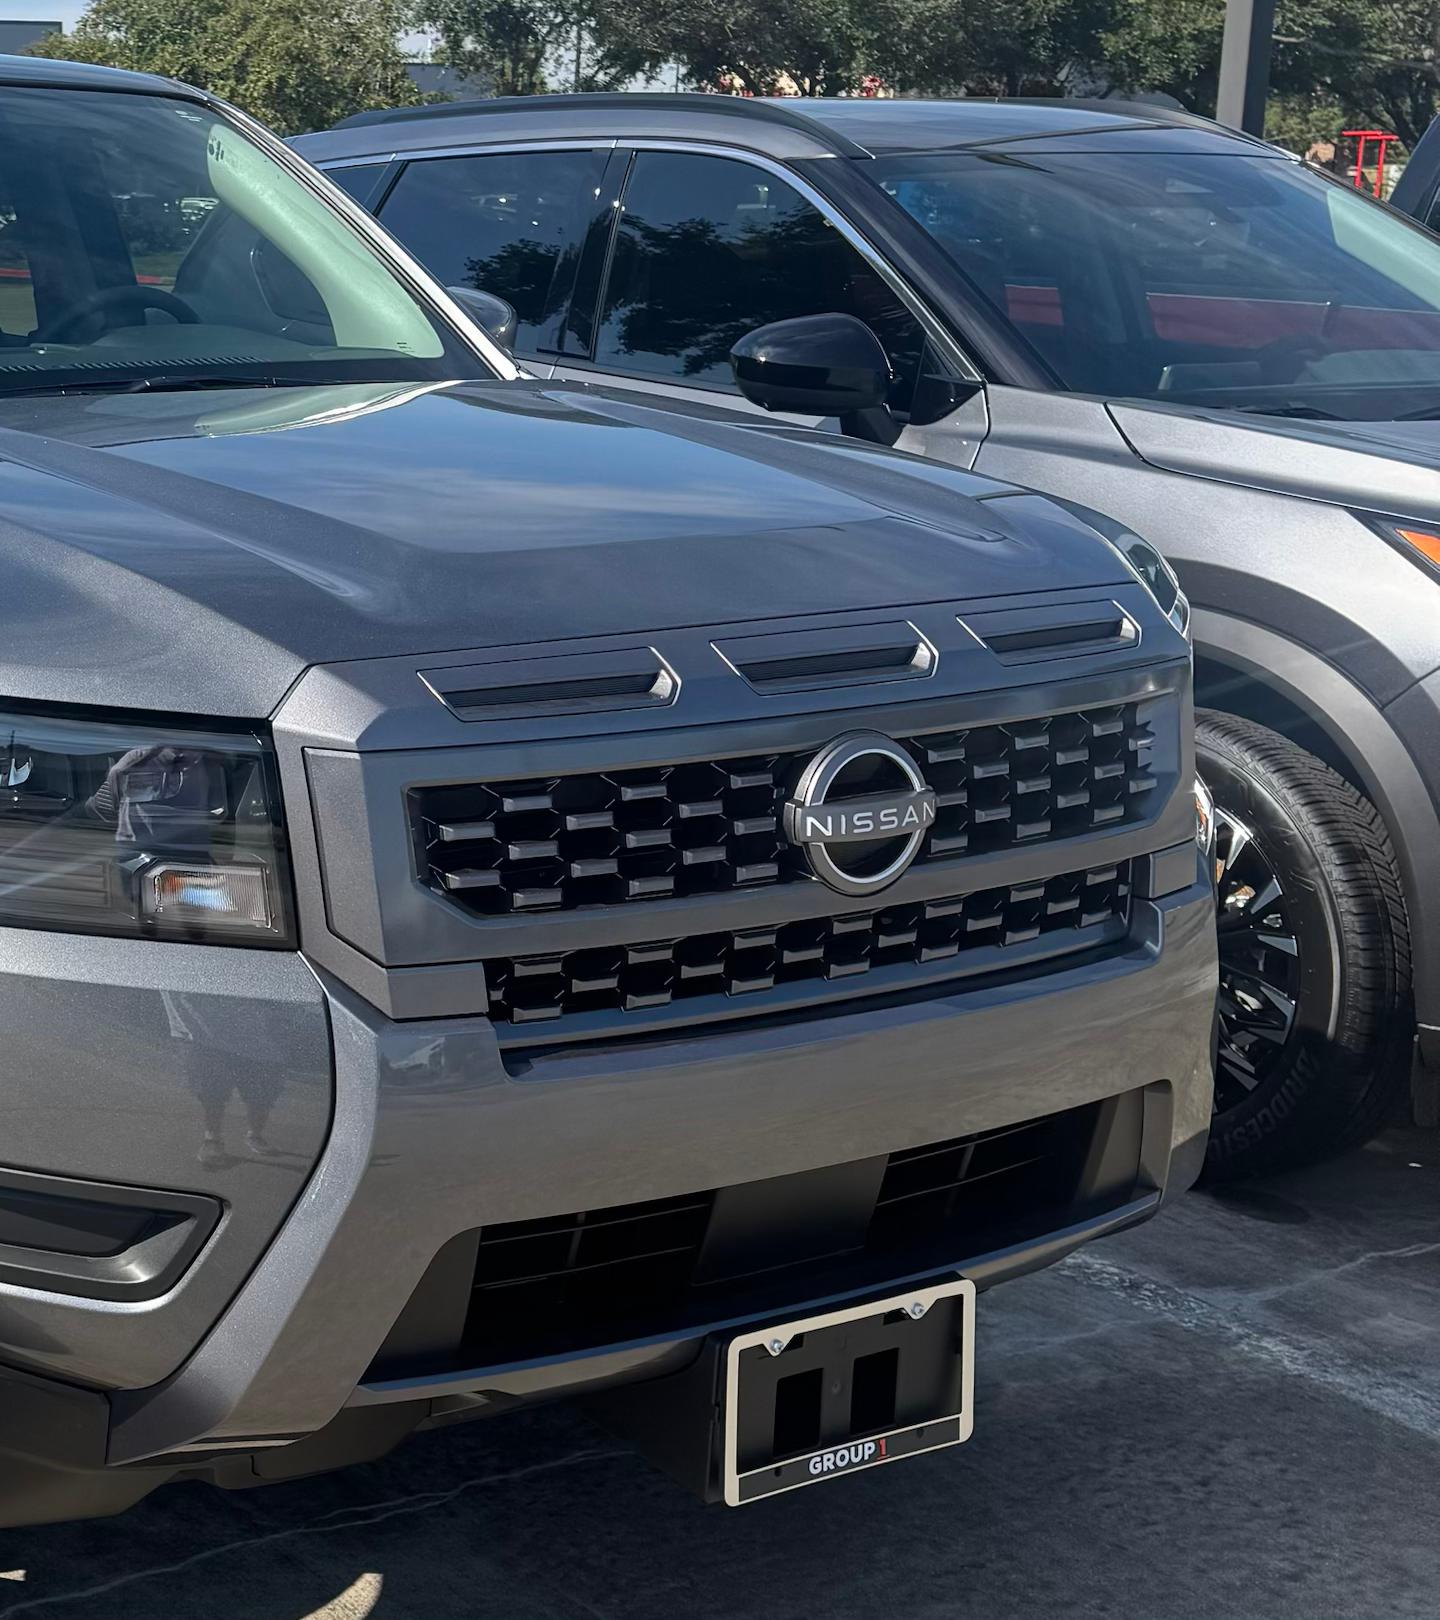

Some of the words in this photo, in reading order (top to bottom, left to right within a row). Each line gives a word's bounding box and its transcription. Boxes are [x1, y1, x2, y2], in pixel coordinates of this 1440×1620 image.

[807, 800, 935, 836] NISSAN
[1208, 1046, 1321, 1162] BRIDGESTO
[809, 1442, 876, 1475] GROUP
